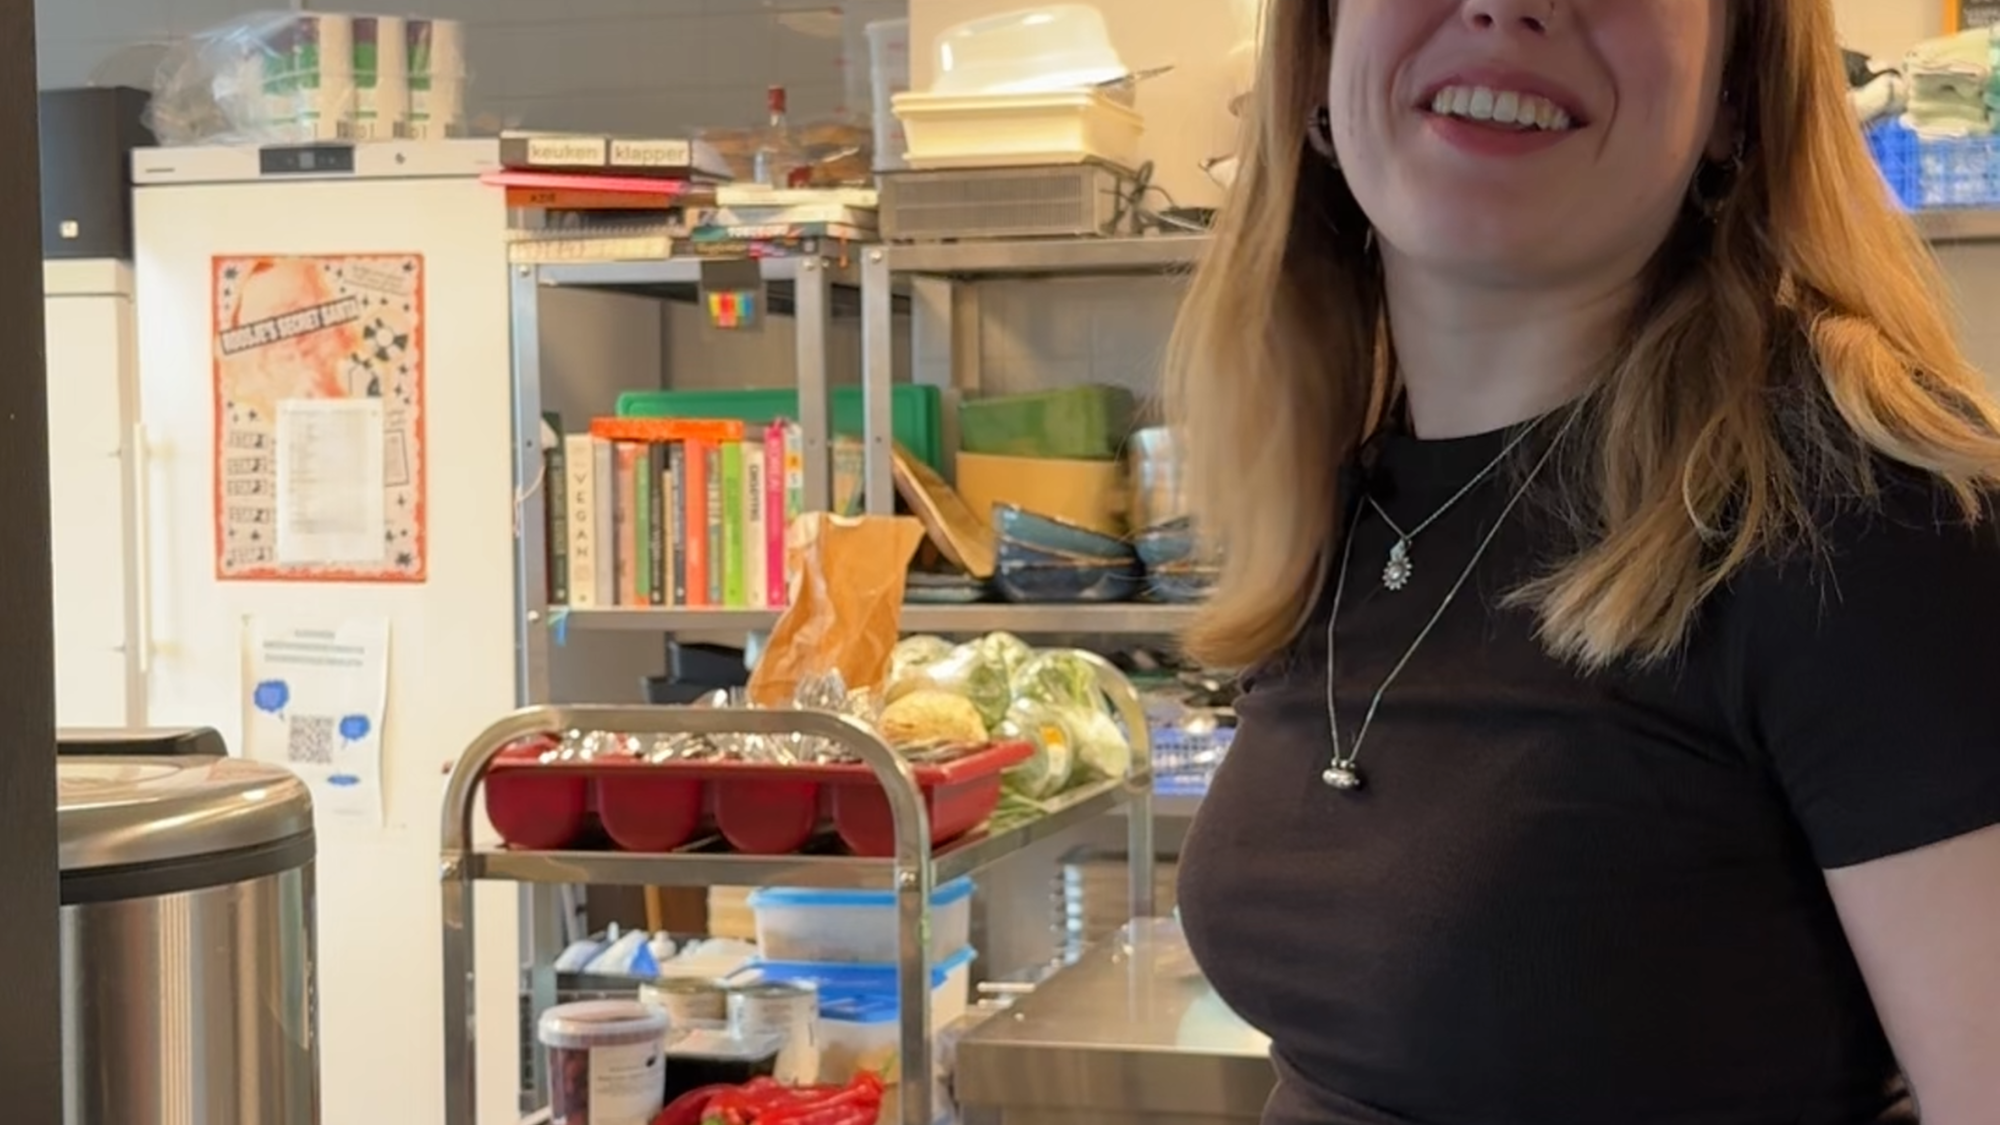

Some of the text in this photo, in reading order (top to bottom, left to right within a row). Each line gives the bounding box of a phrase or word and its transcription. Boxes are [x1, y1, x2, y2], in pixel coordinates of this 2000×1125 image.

[530, 143, 686, 167] keuken klapper
[278, 309, 320, 339] SECRET
[574, 473, 588, 558] VEGAN
